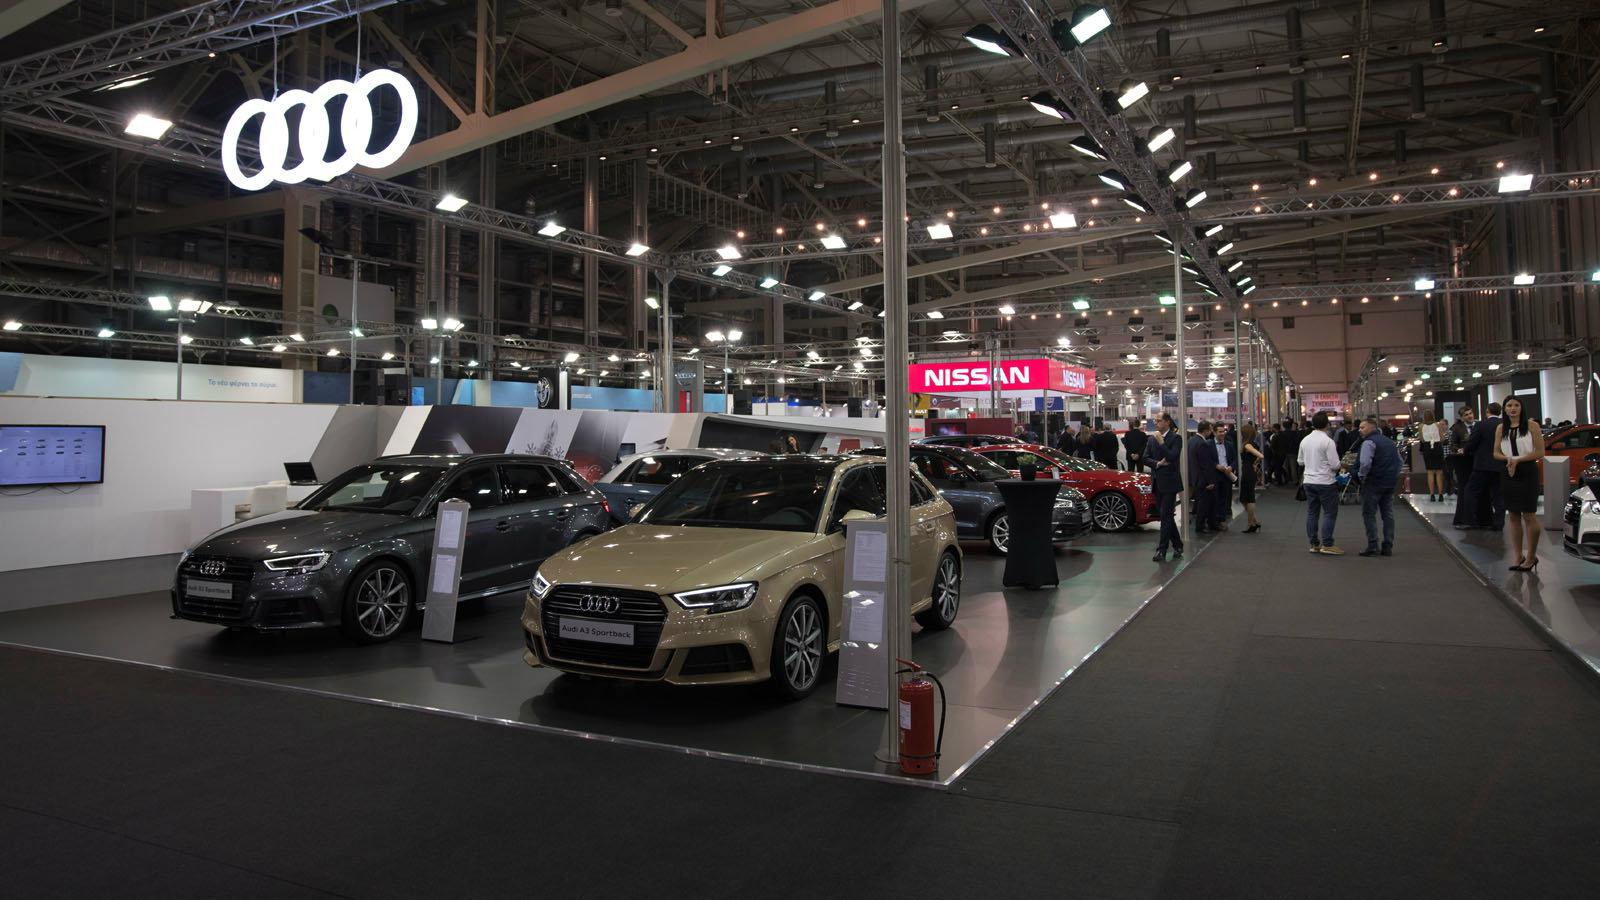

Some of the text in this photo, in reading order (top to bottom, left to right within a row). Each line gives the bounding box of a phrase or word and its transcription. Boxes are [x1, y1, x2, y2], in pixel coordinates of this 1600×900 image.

[924, 366, 1030, 387] NISSAN
[1062, 370, 1085, 389] NISSAN
[562, 624, 579, 633] Audi
[591, 628, 632, 638] Sportback
